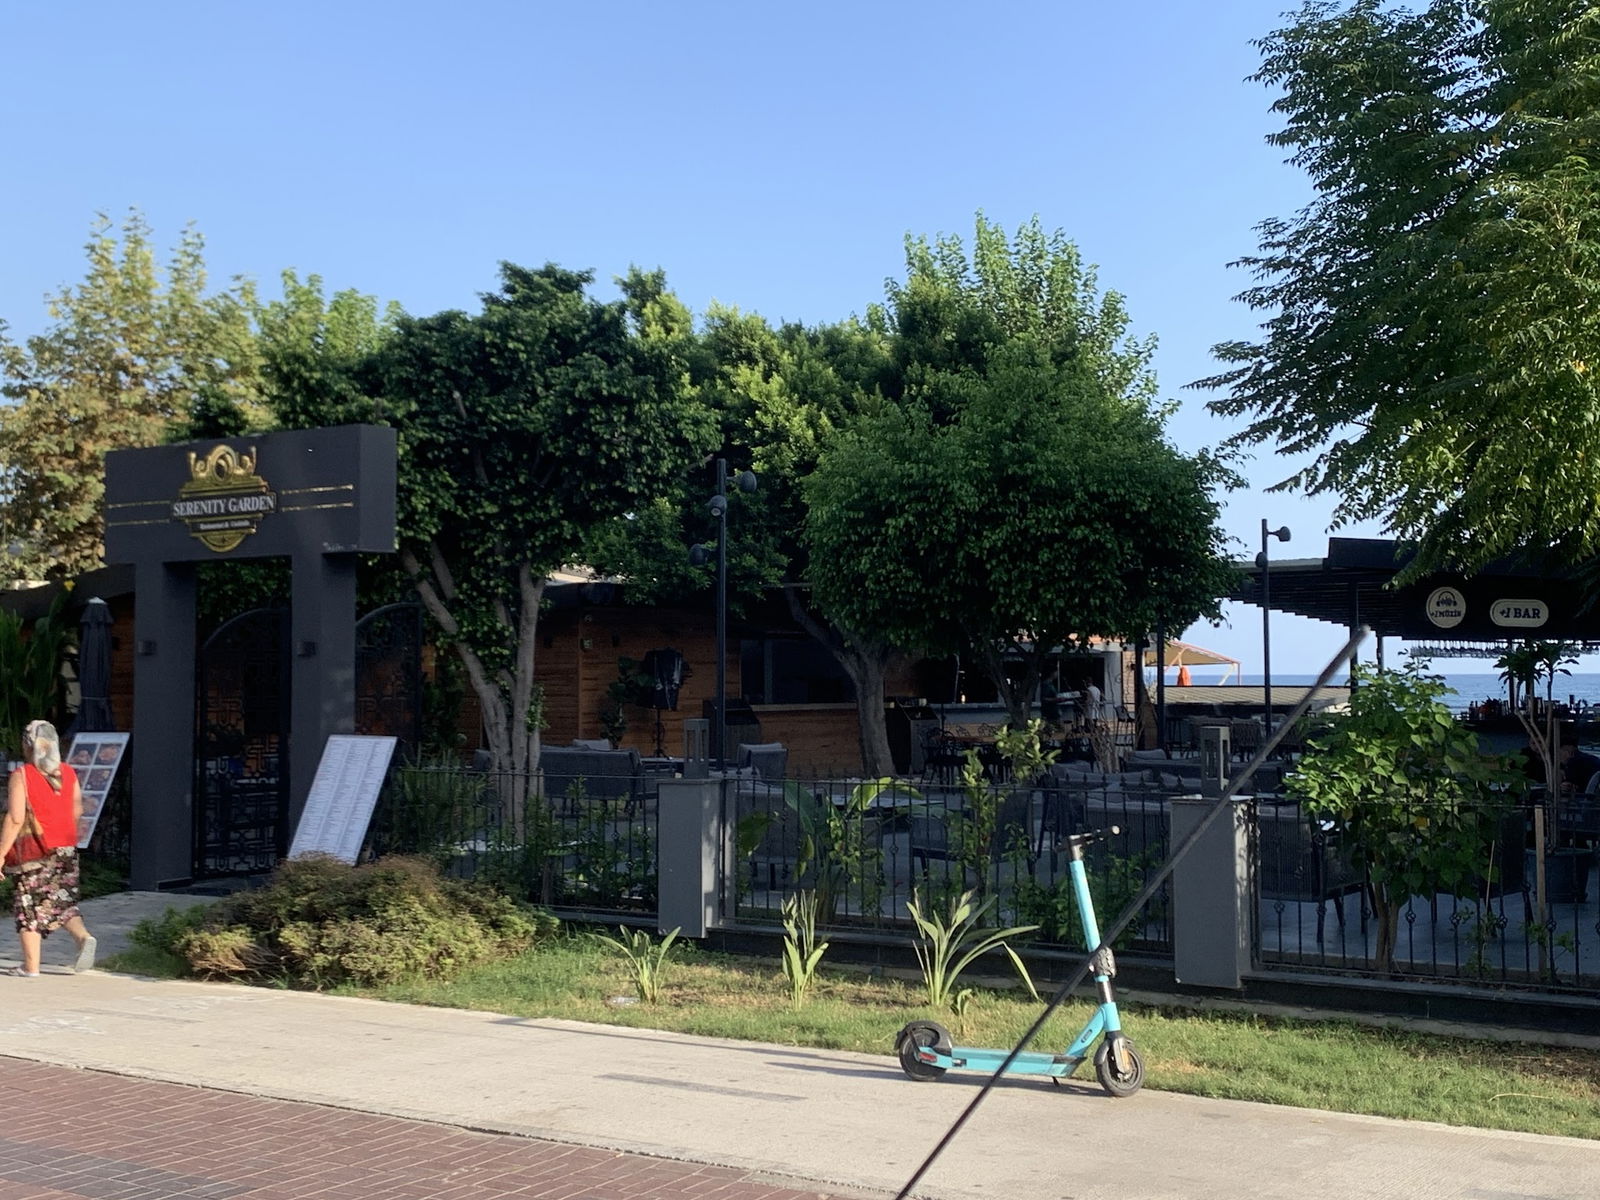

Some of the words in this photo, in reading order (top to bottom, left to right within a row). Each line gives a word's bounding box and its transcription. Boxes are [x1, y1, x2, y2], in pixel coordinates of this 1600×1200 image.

[173, 499, 226, 516] SERENITY
[228, 495, 275, 513] GARDEN
[1513, 608, 1541, 619] BAR
